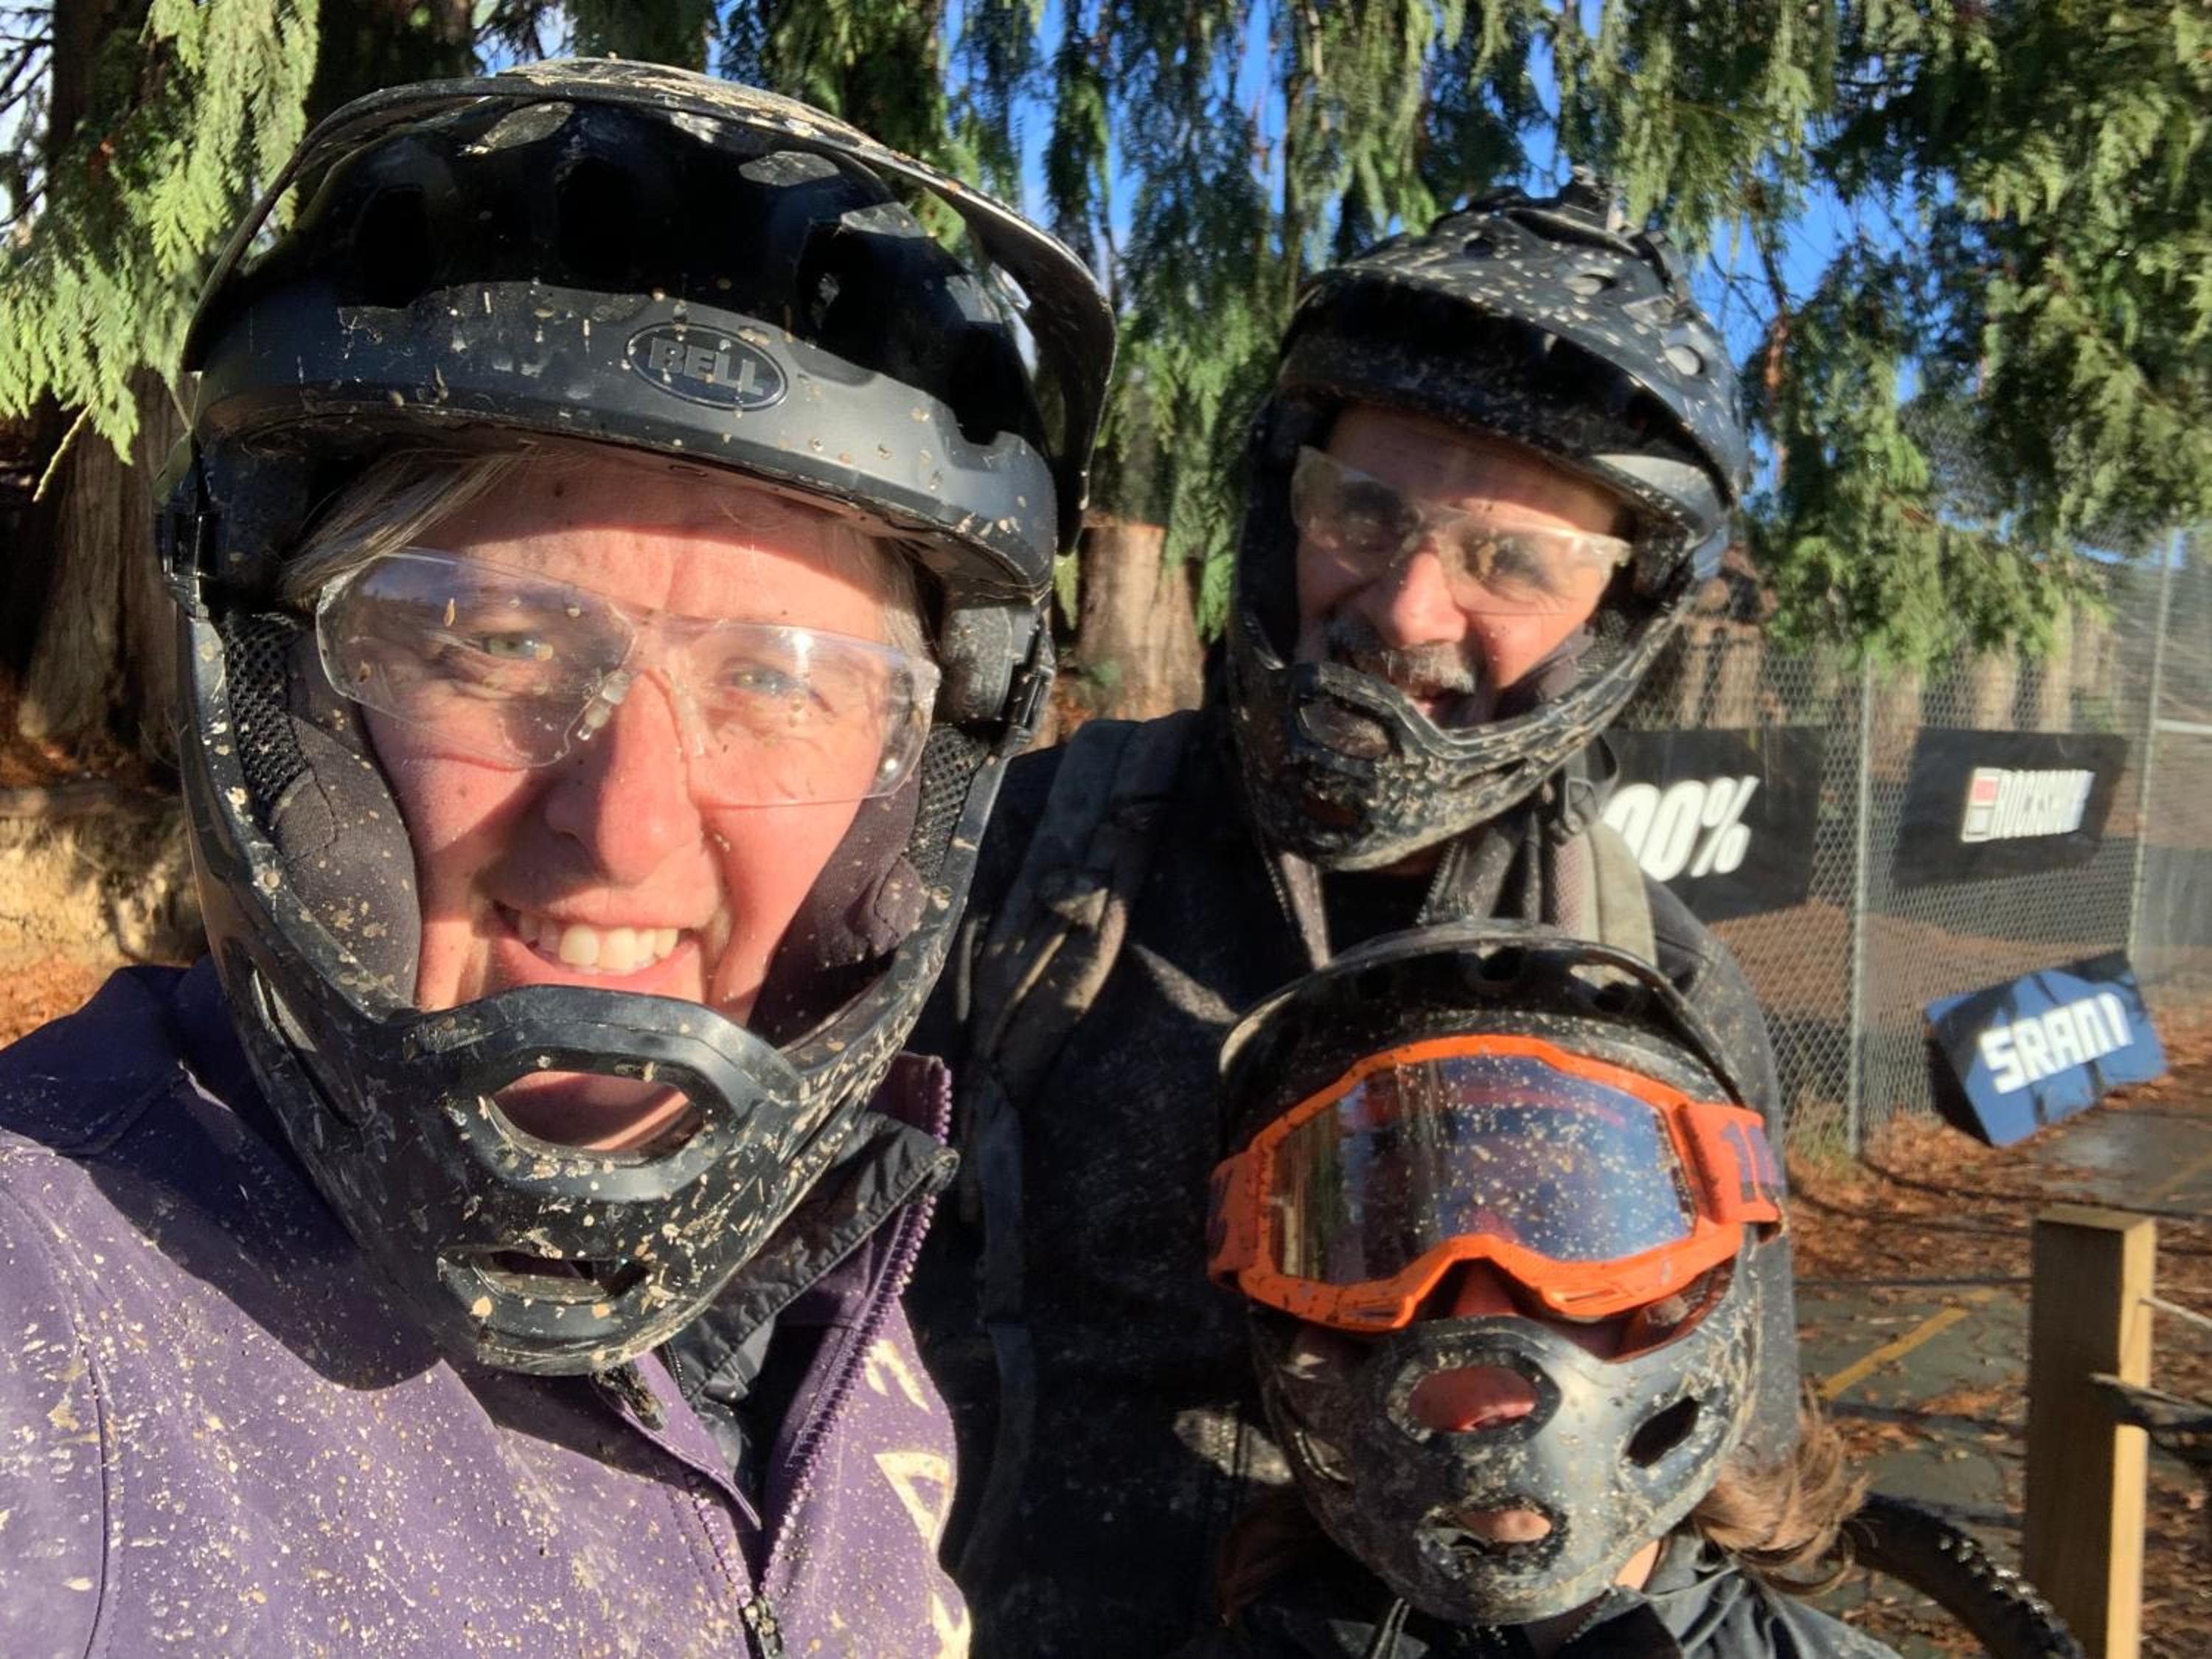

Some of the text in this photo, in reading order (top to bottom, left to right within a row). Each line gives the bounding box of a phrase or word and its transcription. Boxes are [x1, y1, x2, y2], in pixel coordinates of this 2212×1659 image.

[649, 337, 764, 396] BELL
[1602, 776, 1759, 881] 00%
[1980, 992, 2133, 1094] SRAM
